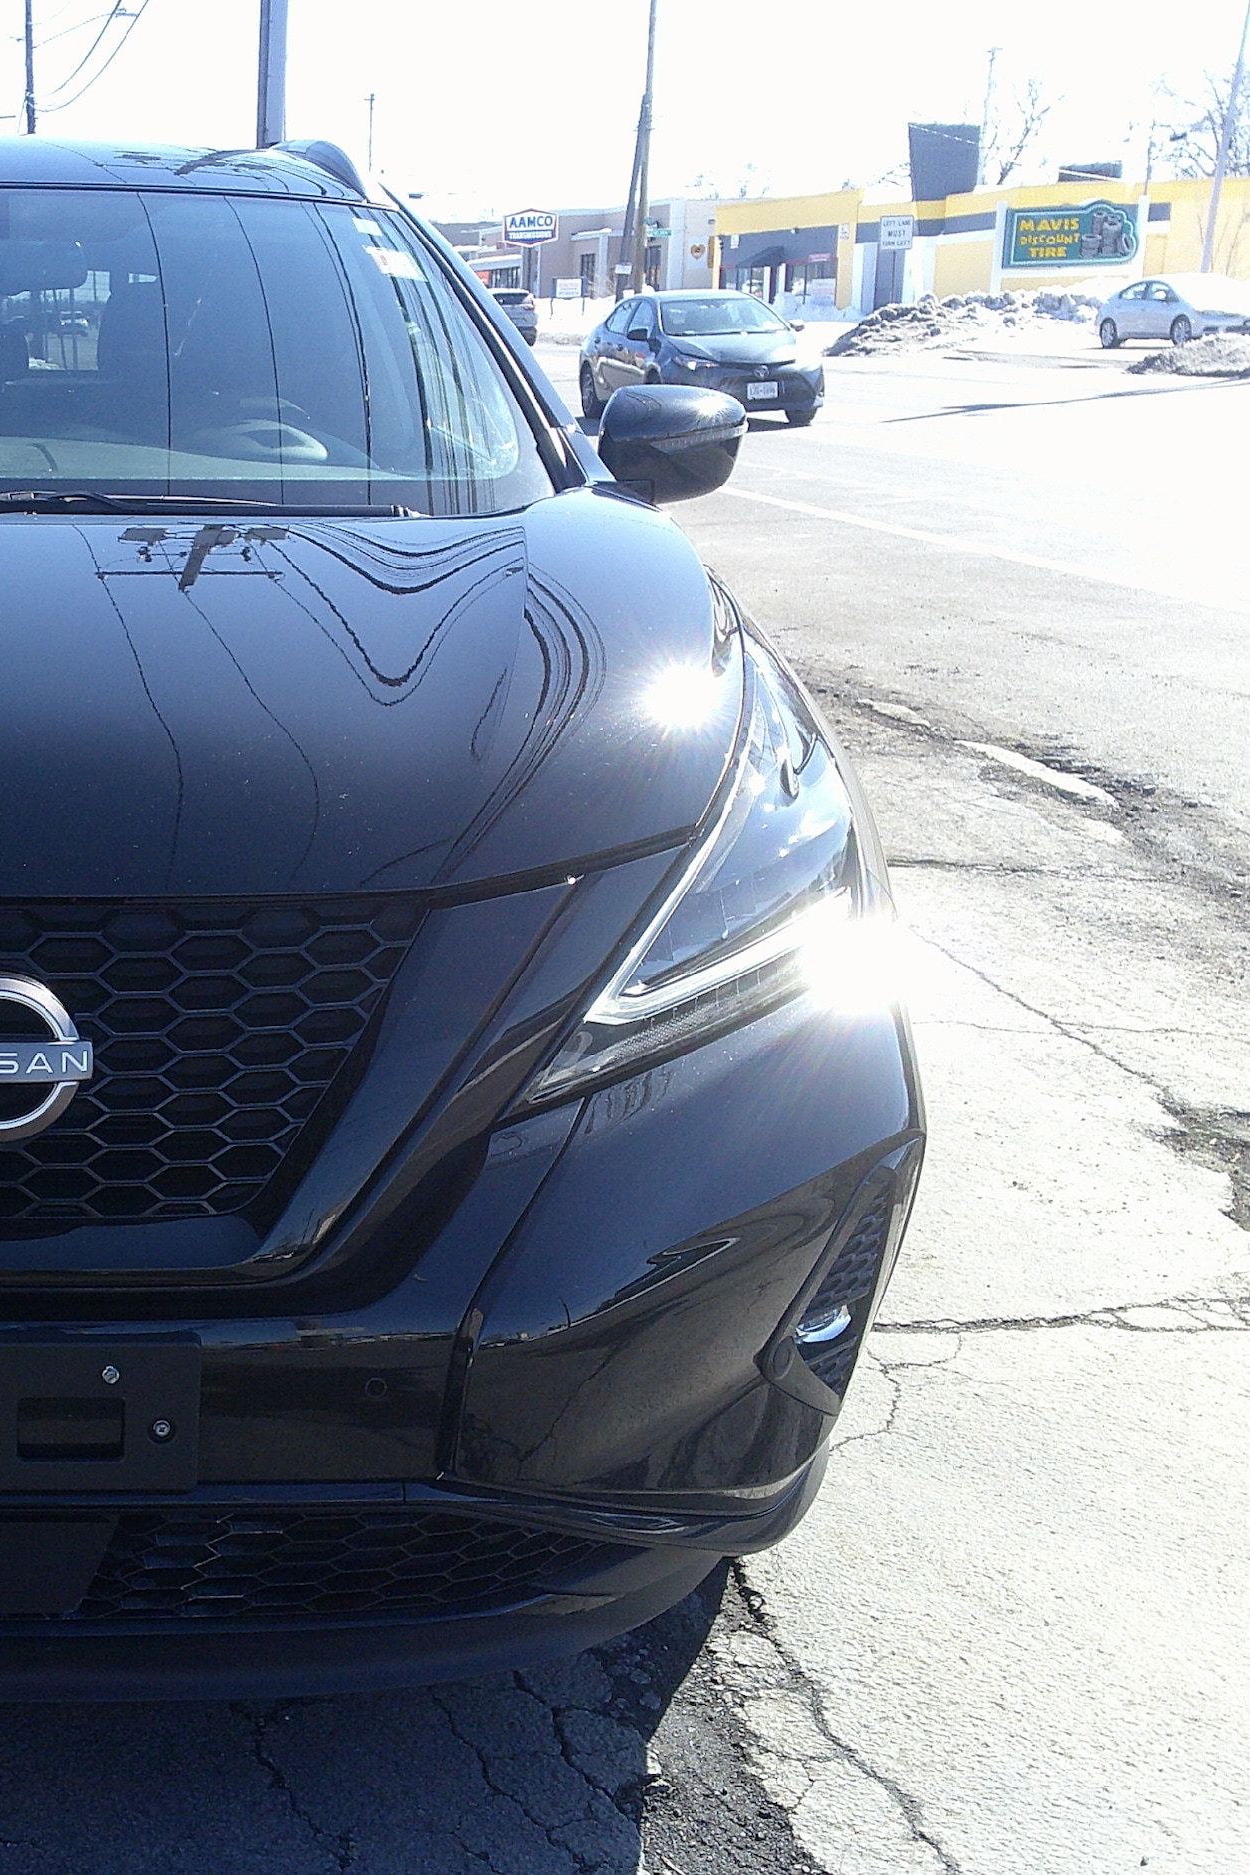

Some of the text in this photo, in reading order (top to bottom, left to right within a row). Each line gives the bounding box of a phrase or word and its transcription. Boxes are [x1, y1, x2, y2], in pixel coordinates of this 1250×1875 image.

[509, 216, 553, 228] AAMCO
[1019, 218, 1079, 231] MAVIS
[1020, 233, 1080, 246] DISCOUNT
[1029, 246, 1067, 258] TIRE
